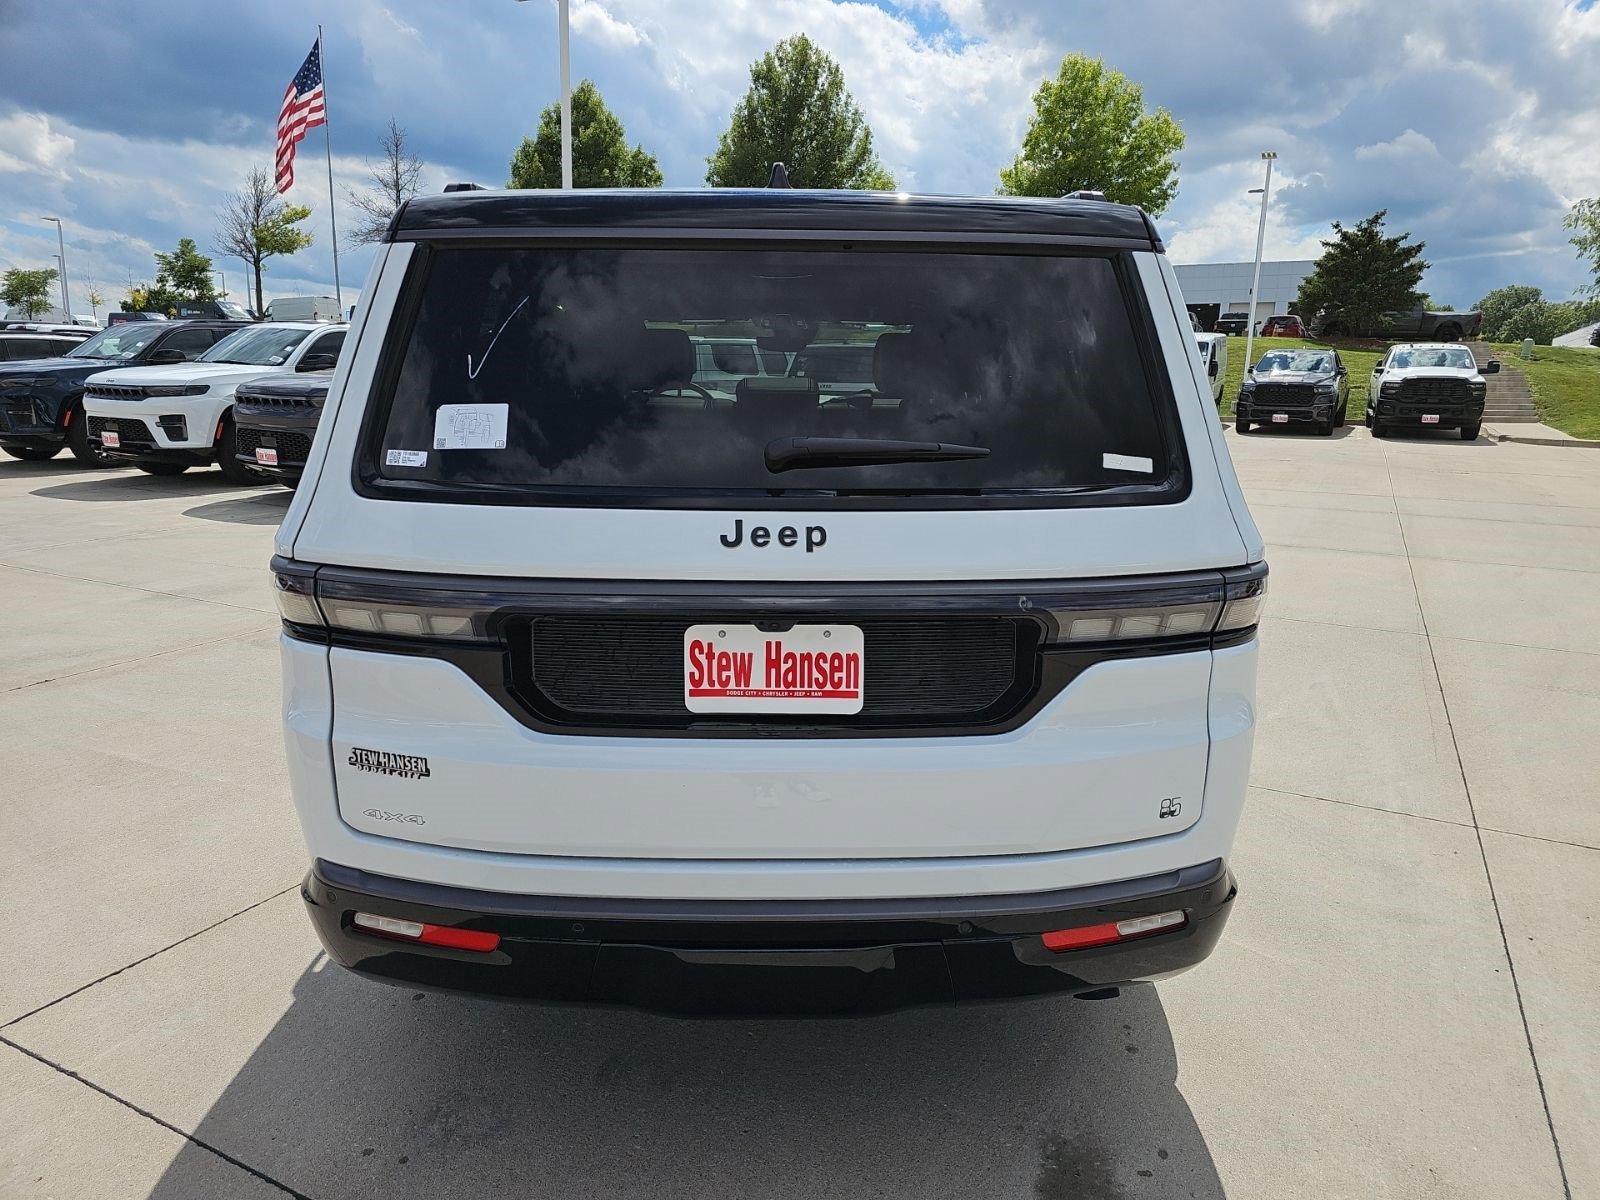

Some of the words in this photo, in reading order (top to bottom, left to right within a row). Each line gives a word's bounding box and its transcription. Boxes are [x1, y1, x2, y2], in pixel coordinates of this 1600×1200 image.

[720, 519, 827, 553] Jeep
[689, 639, 754, 689] Stew
[765, 640, 860, 690] Hansen
[348, 747, 380, 766] STEW
[381, 752, 428, 774] HANSEN
